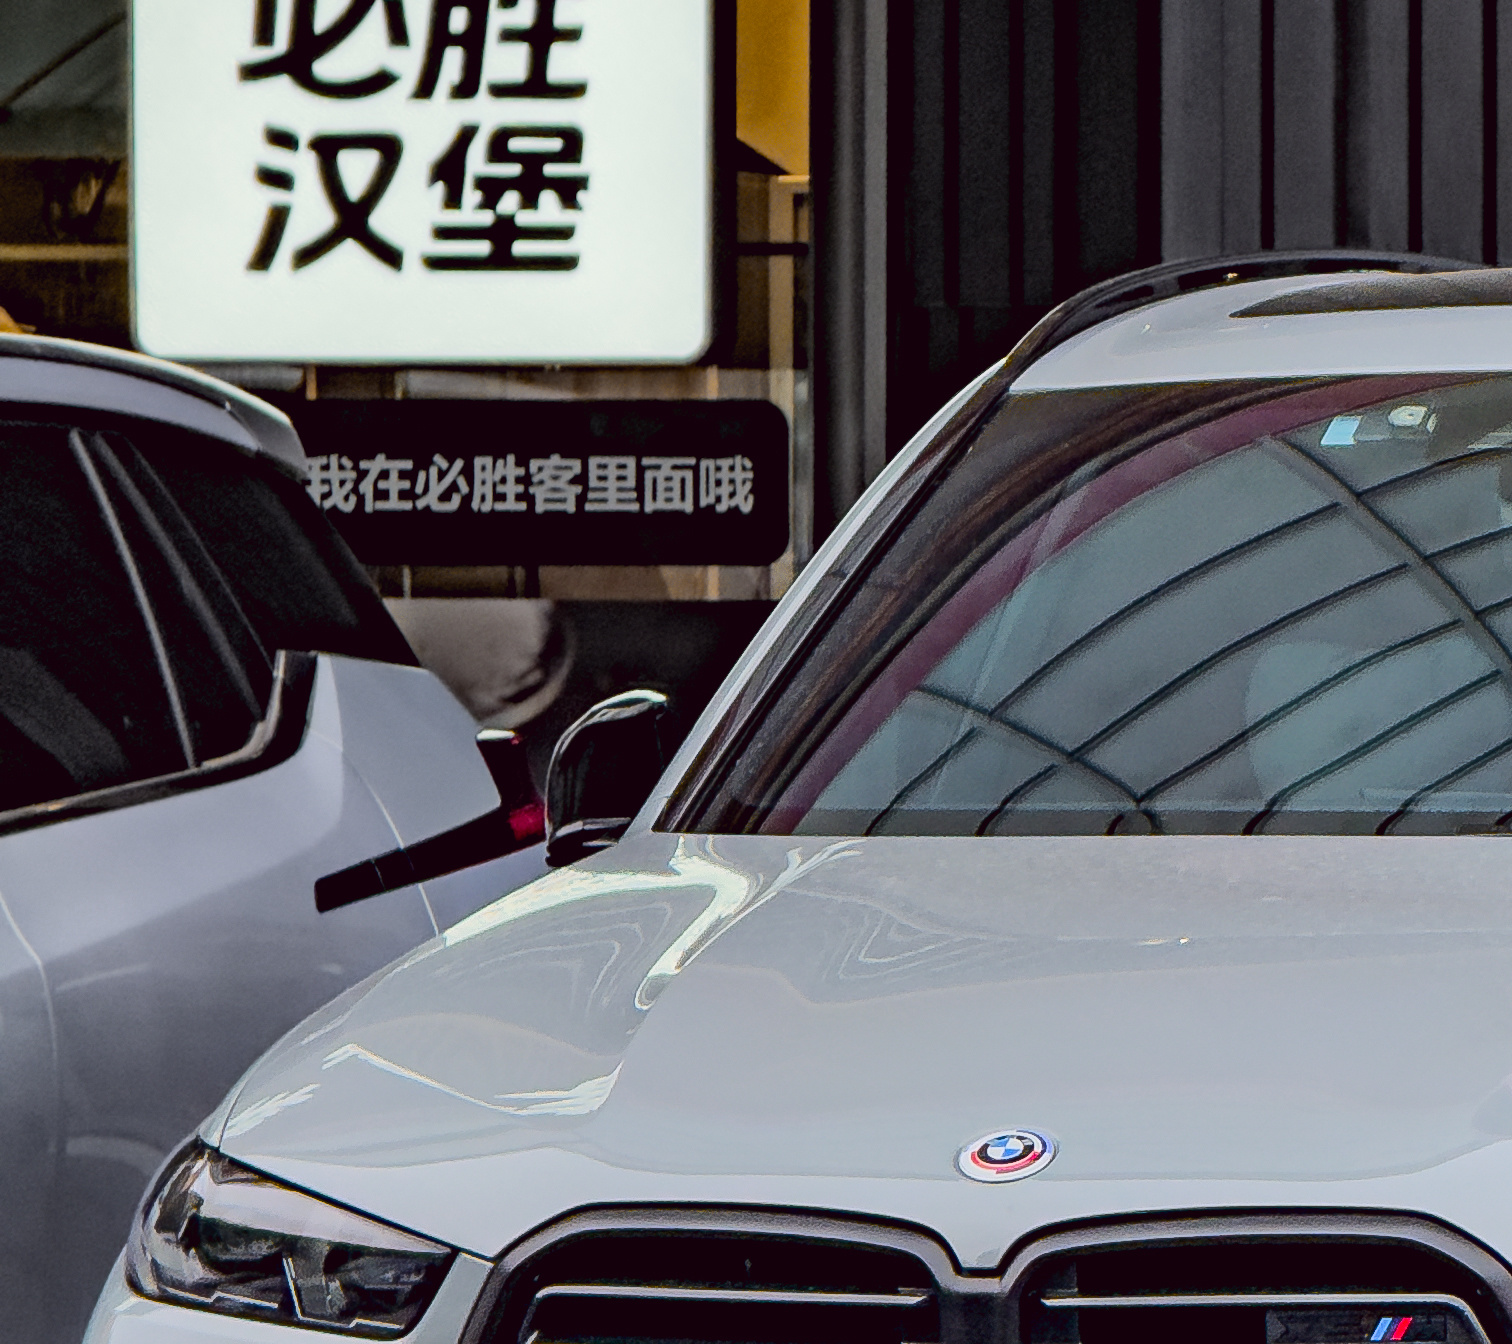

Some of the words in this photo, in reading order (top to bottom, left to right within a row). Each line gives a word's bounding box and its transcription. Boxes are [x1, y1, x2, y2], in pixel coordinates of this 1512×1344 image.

[245, 124, 590, 273] 汉堡
[302, 453, 755, 515] 我在必胜客里面哦
